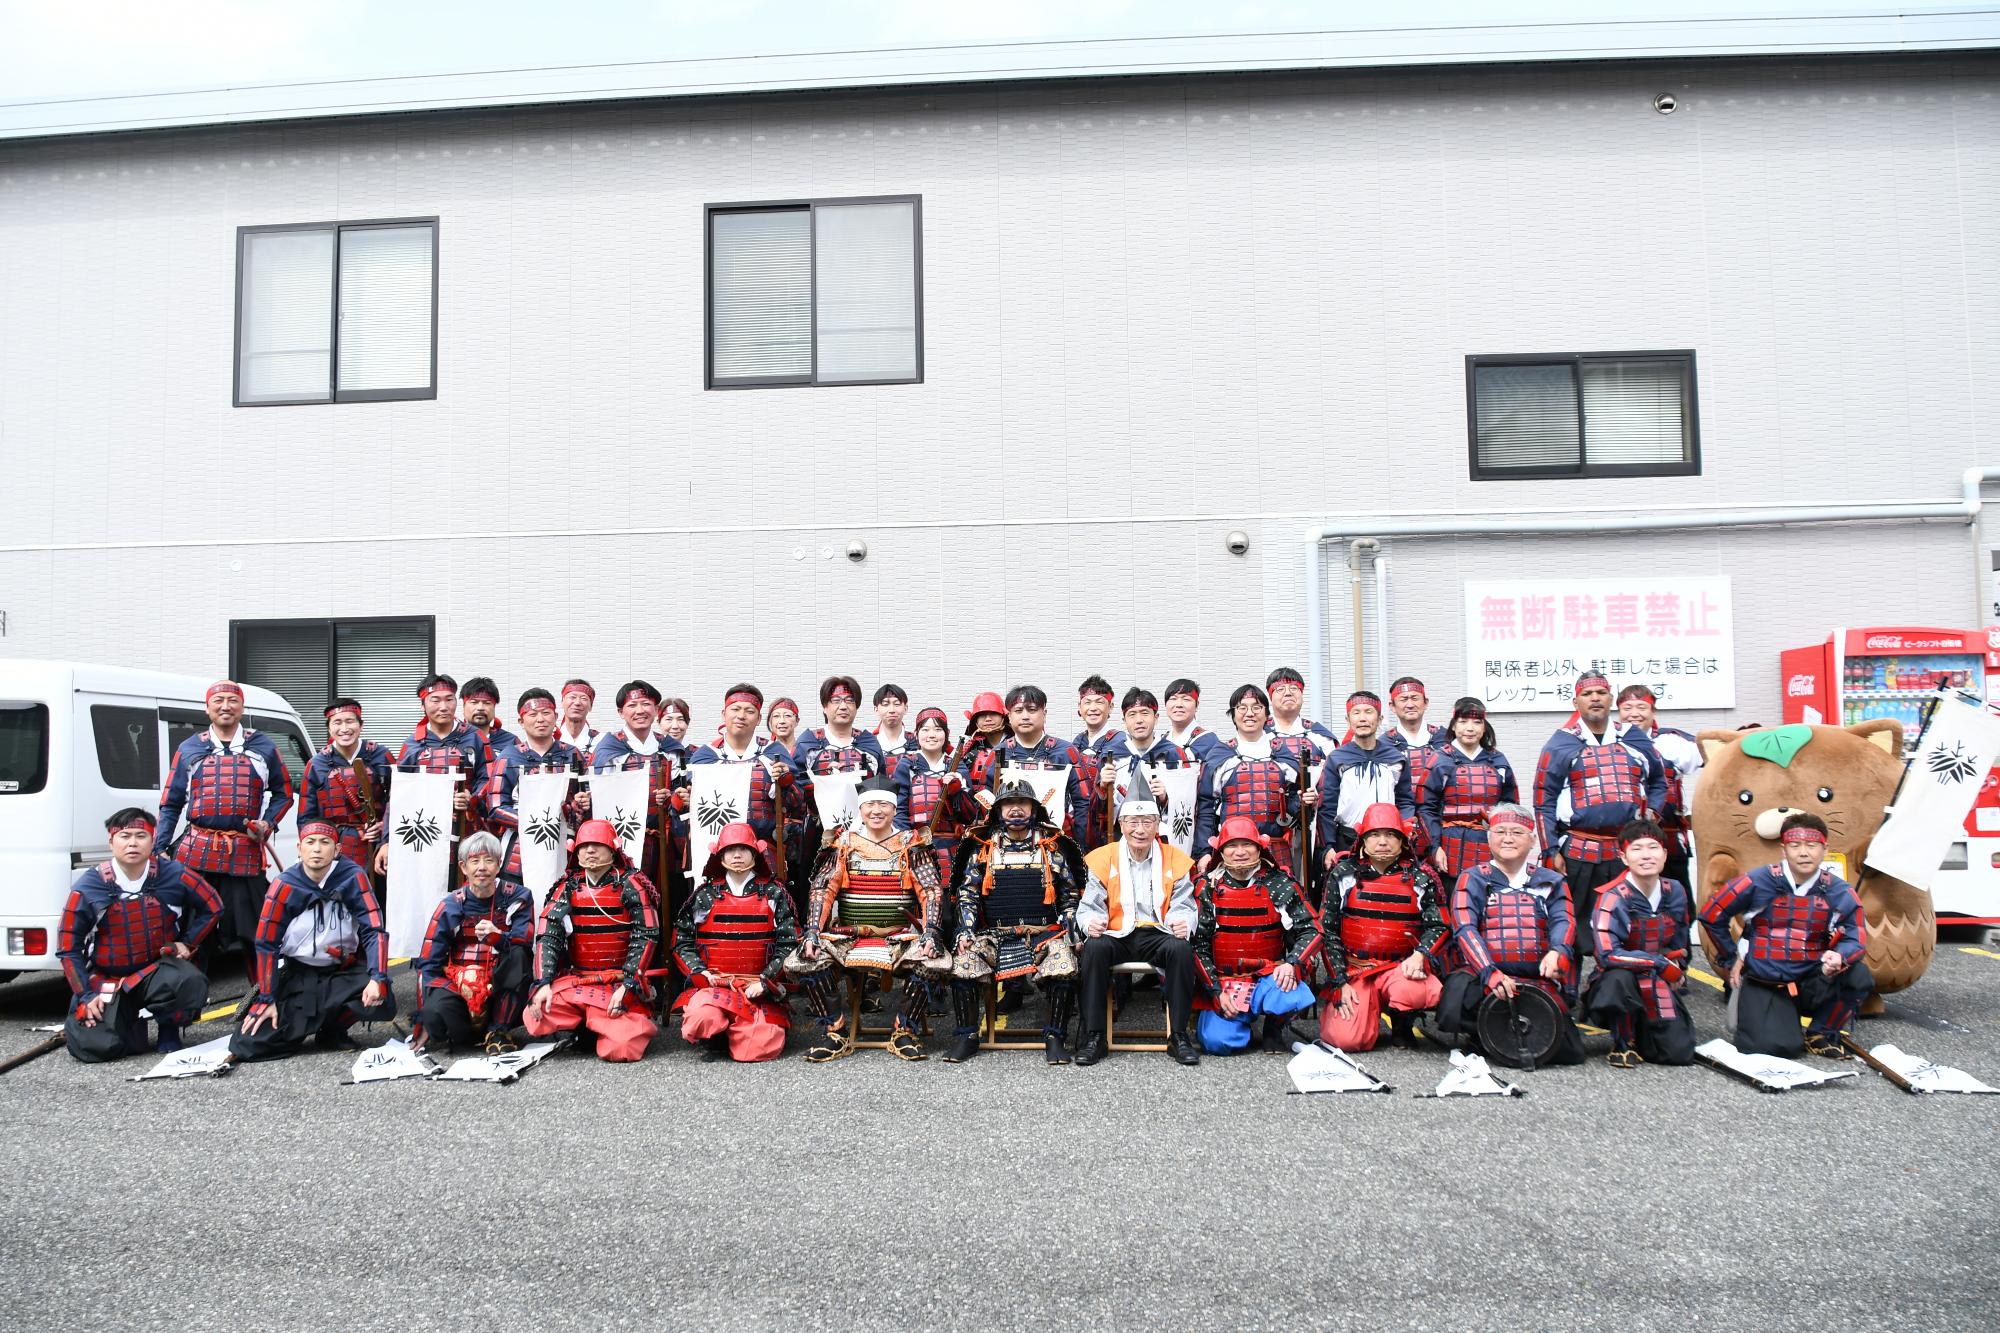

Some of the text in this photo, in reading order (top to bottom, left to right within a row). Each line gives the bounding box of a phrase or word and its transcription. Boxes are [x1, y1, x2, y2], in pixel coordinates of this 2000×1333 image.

[1480, 592, 1720, 641] 無断駐車禁止
